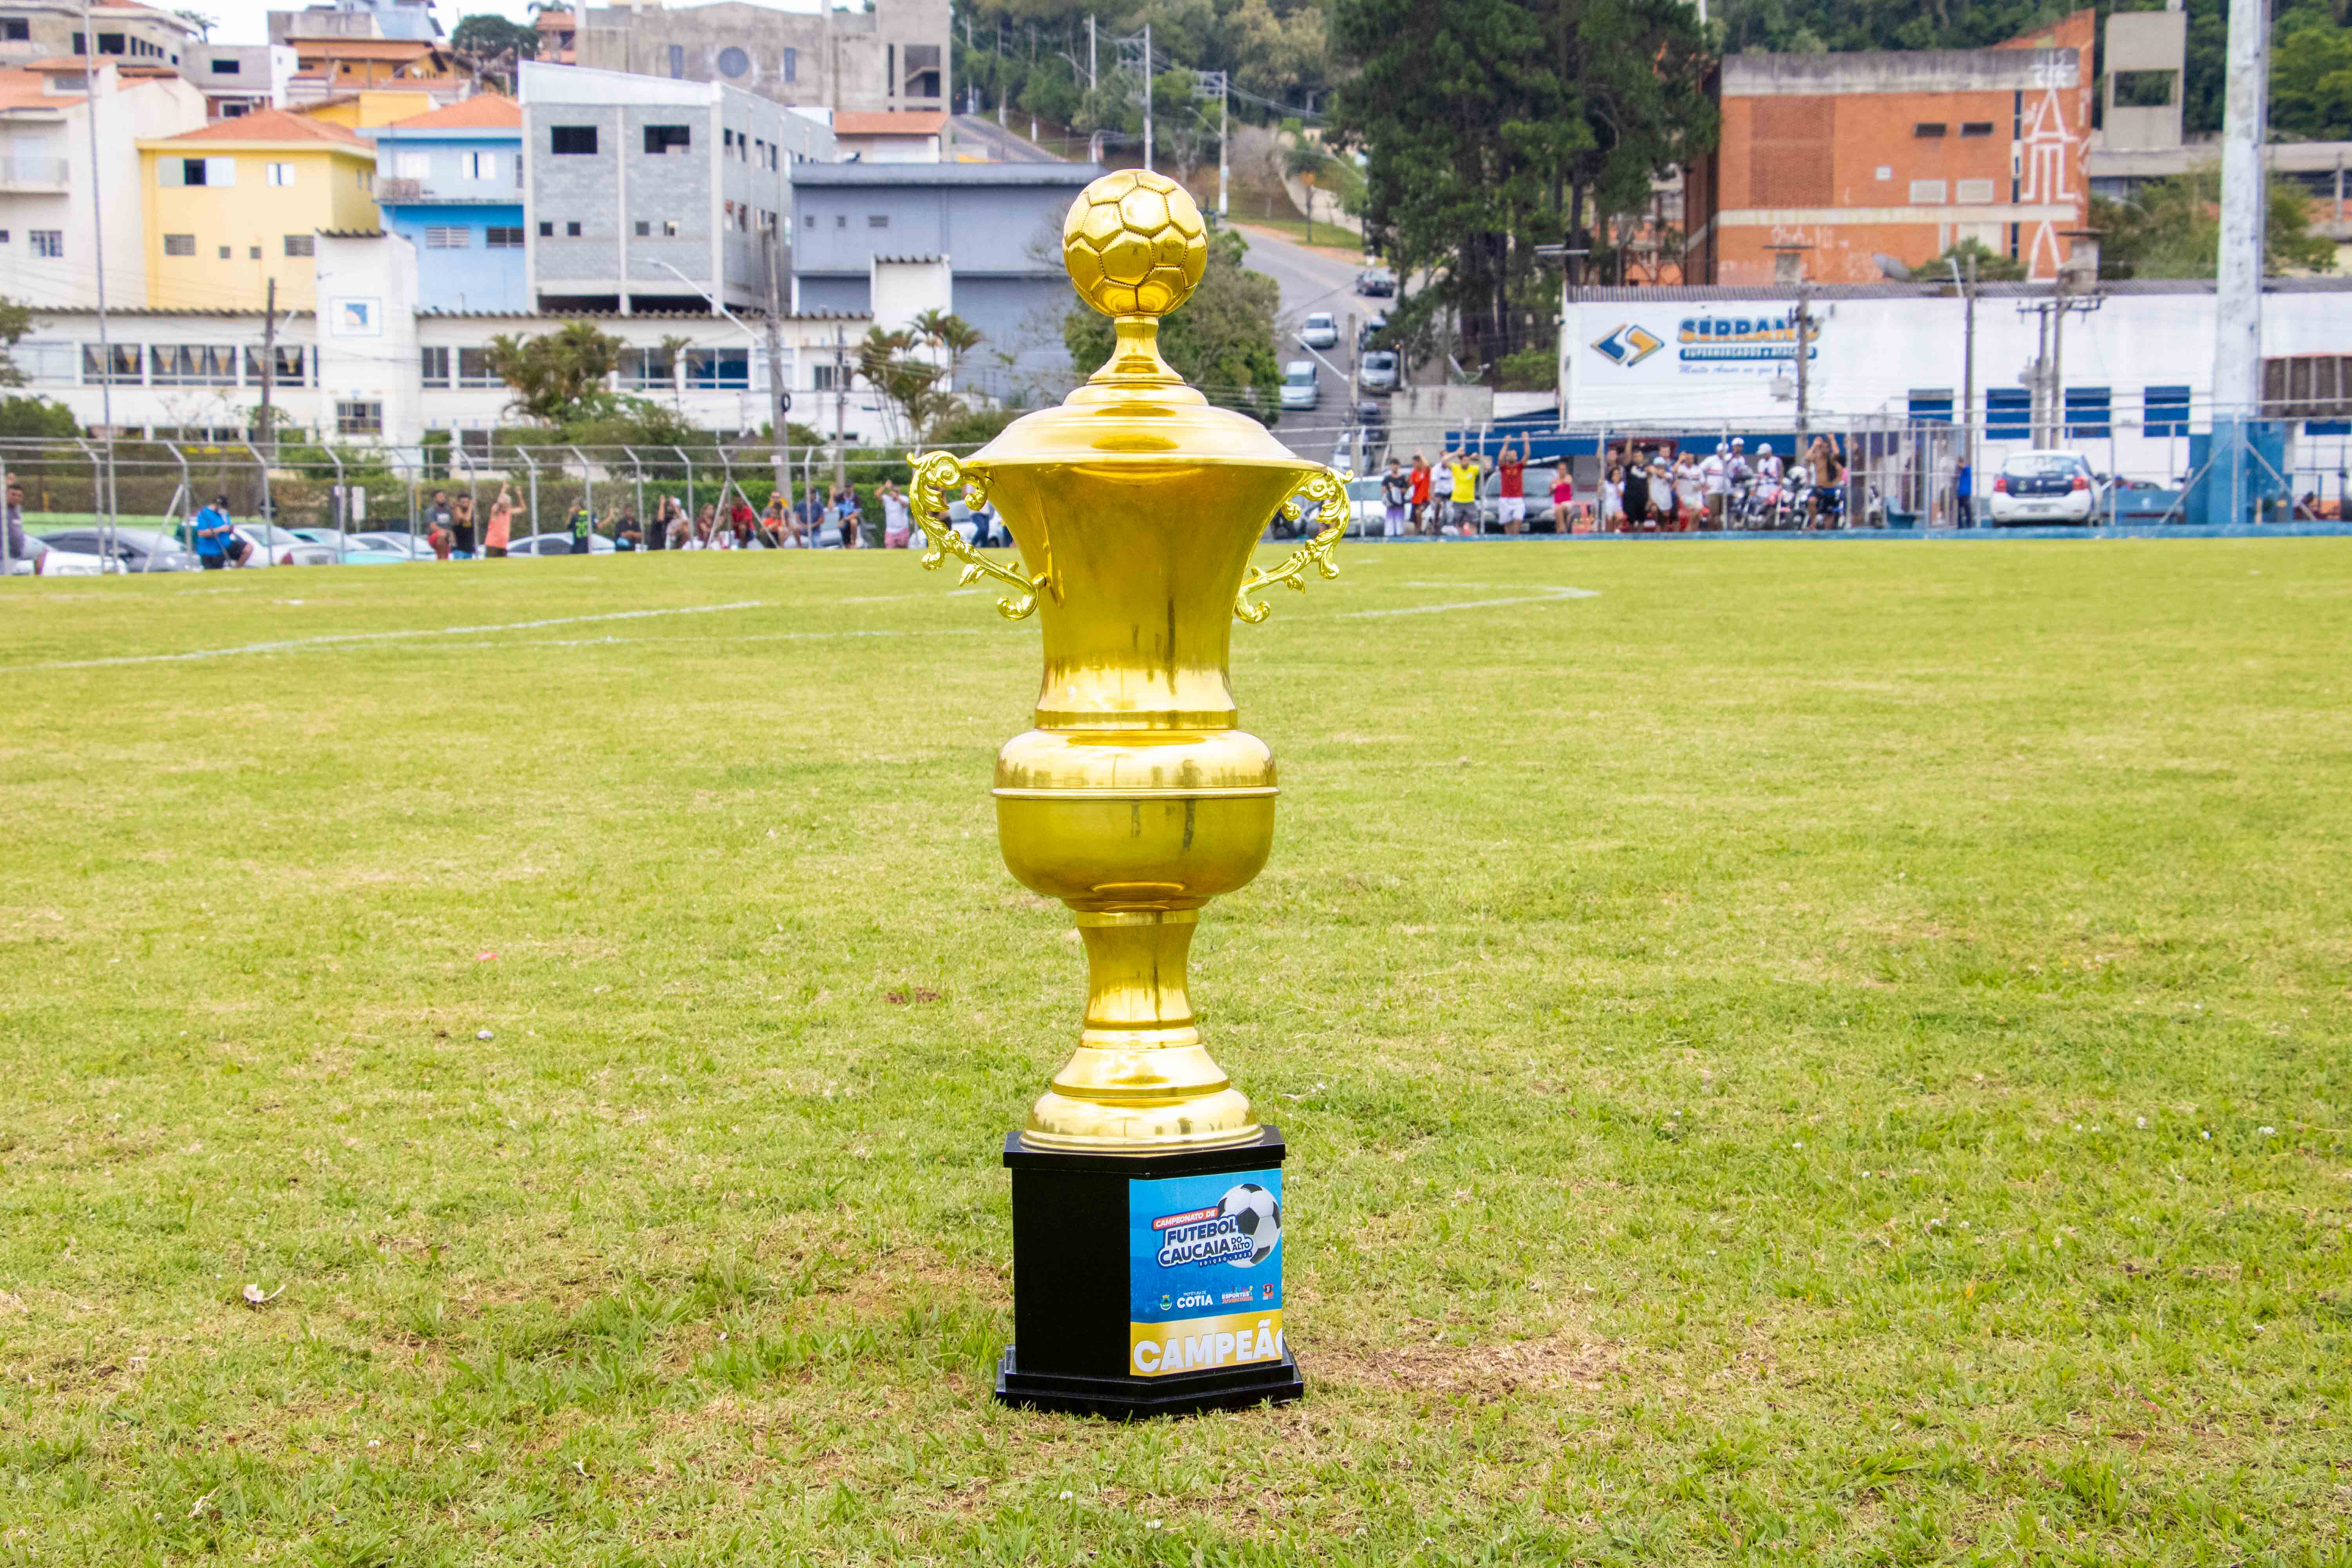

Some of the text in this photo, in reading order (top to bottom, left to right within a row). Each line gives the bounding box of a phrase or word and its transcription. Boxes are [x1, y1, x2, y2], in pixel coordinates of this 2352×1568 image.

[1156, 1210, 1215, 1227] CAMPEONATO DE
[1167, 1219, 1236, 1246] FUTEBOL
[1160, 1239, 1231, 1265] CAUCAIA
[1232, 1242, 1250, 1251] ALTO
[1177, 1294, 1213, 1308] COTIA
[1133, 1318, 1283, 1373] CAMPEÃ
